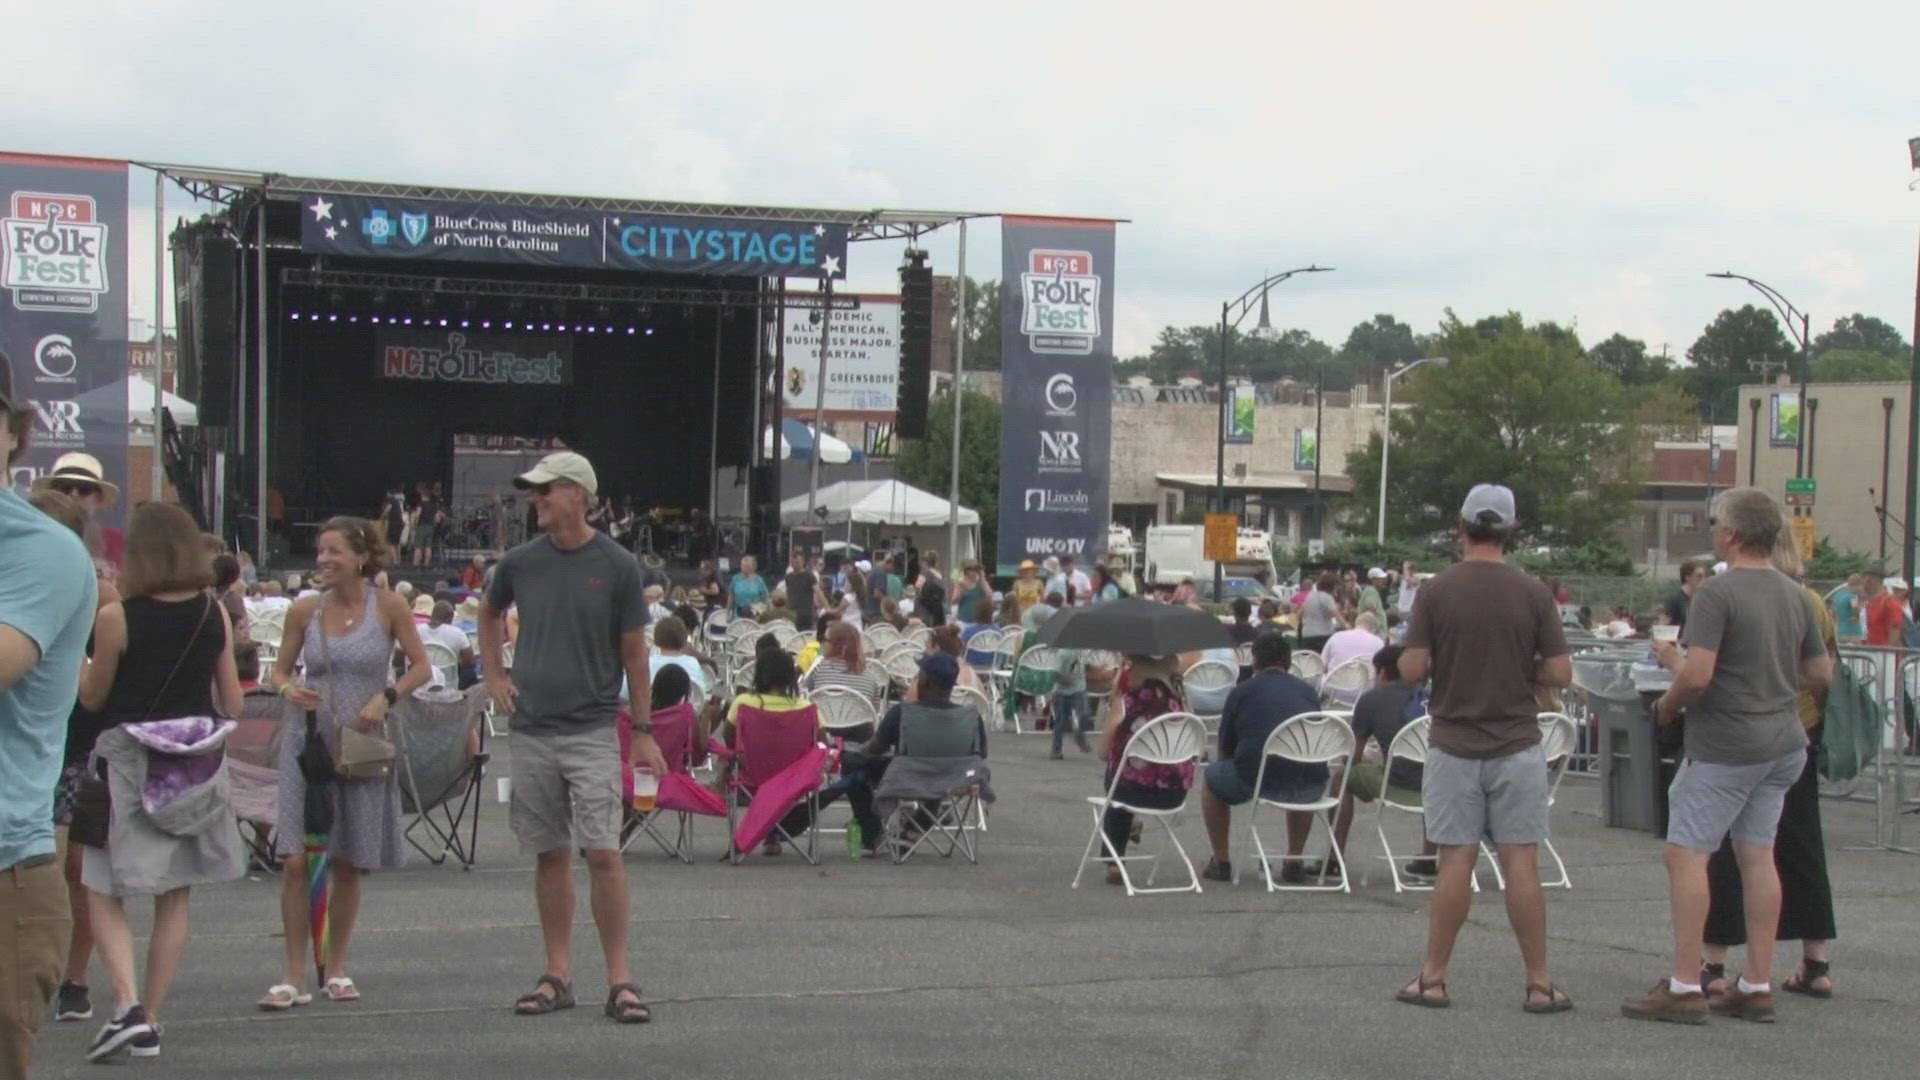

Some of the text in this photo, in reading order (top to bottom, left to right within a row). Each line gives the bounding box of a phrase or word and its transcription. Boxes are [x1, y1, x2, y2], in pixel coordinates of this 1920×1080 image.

[434, 215, 590, 237] BlueCross BlueShield
[14, 226, 95, 258] Folk
[434, 234, 559, 252] of North Carolina
[621, 225, 816, 265] CITYSTAGE
[18, 254, 92, 284] Fest
[1031, 280, 1091, 306] Folk
[1034, 304, 1088, 329] Fest
[793, 324, 889, 335] ALL-MERICAN.
[786, 336, 845, 346] BUSINSS
[830, 373, 895, 384] GREENSBORO
[1047, 489, 1088, 504] Lincoln
